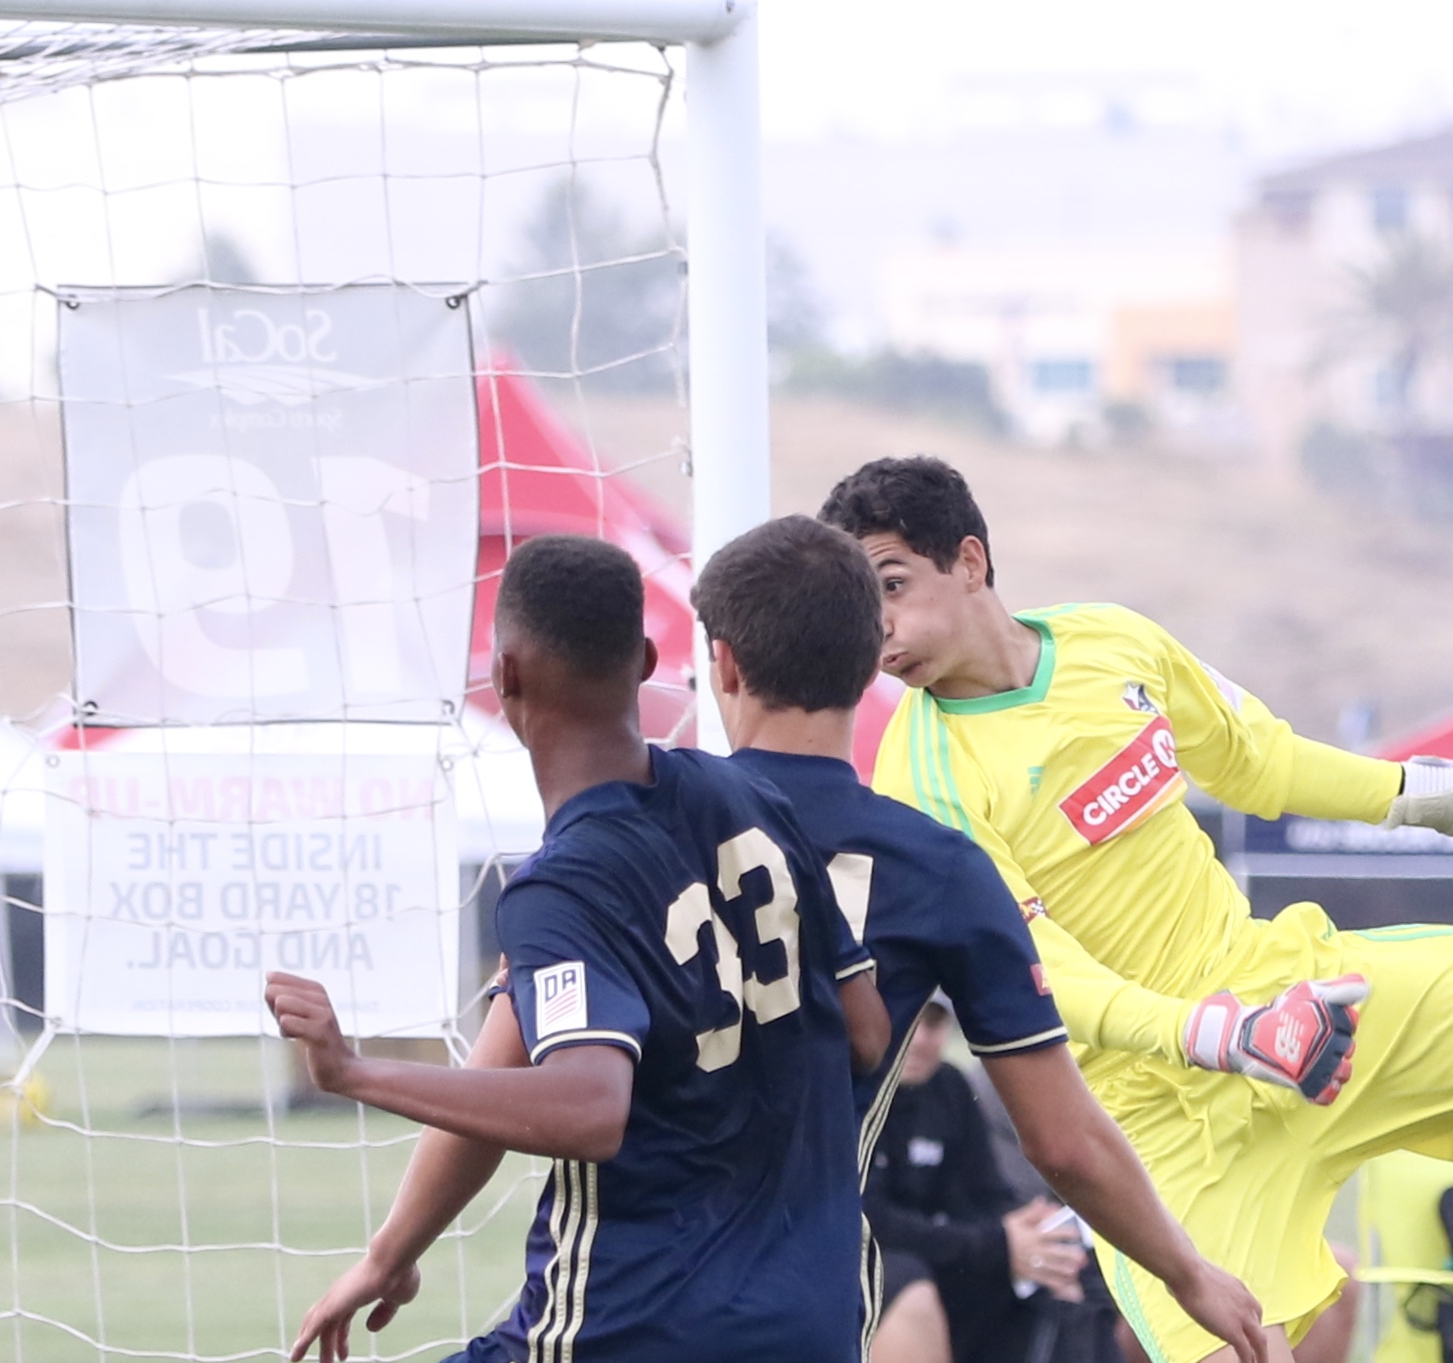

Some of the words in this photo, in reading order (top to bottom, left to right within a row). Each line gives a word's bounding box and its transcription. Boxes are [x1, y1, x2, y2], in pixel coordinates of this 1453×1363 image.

[1082, 752, 1161, 826] CIRCLE
[544, 969, 577, 1004] DA
[664, 827, 801, 1073] 33
